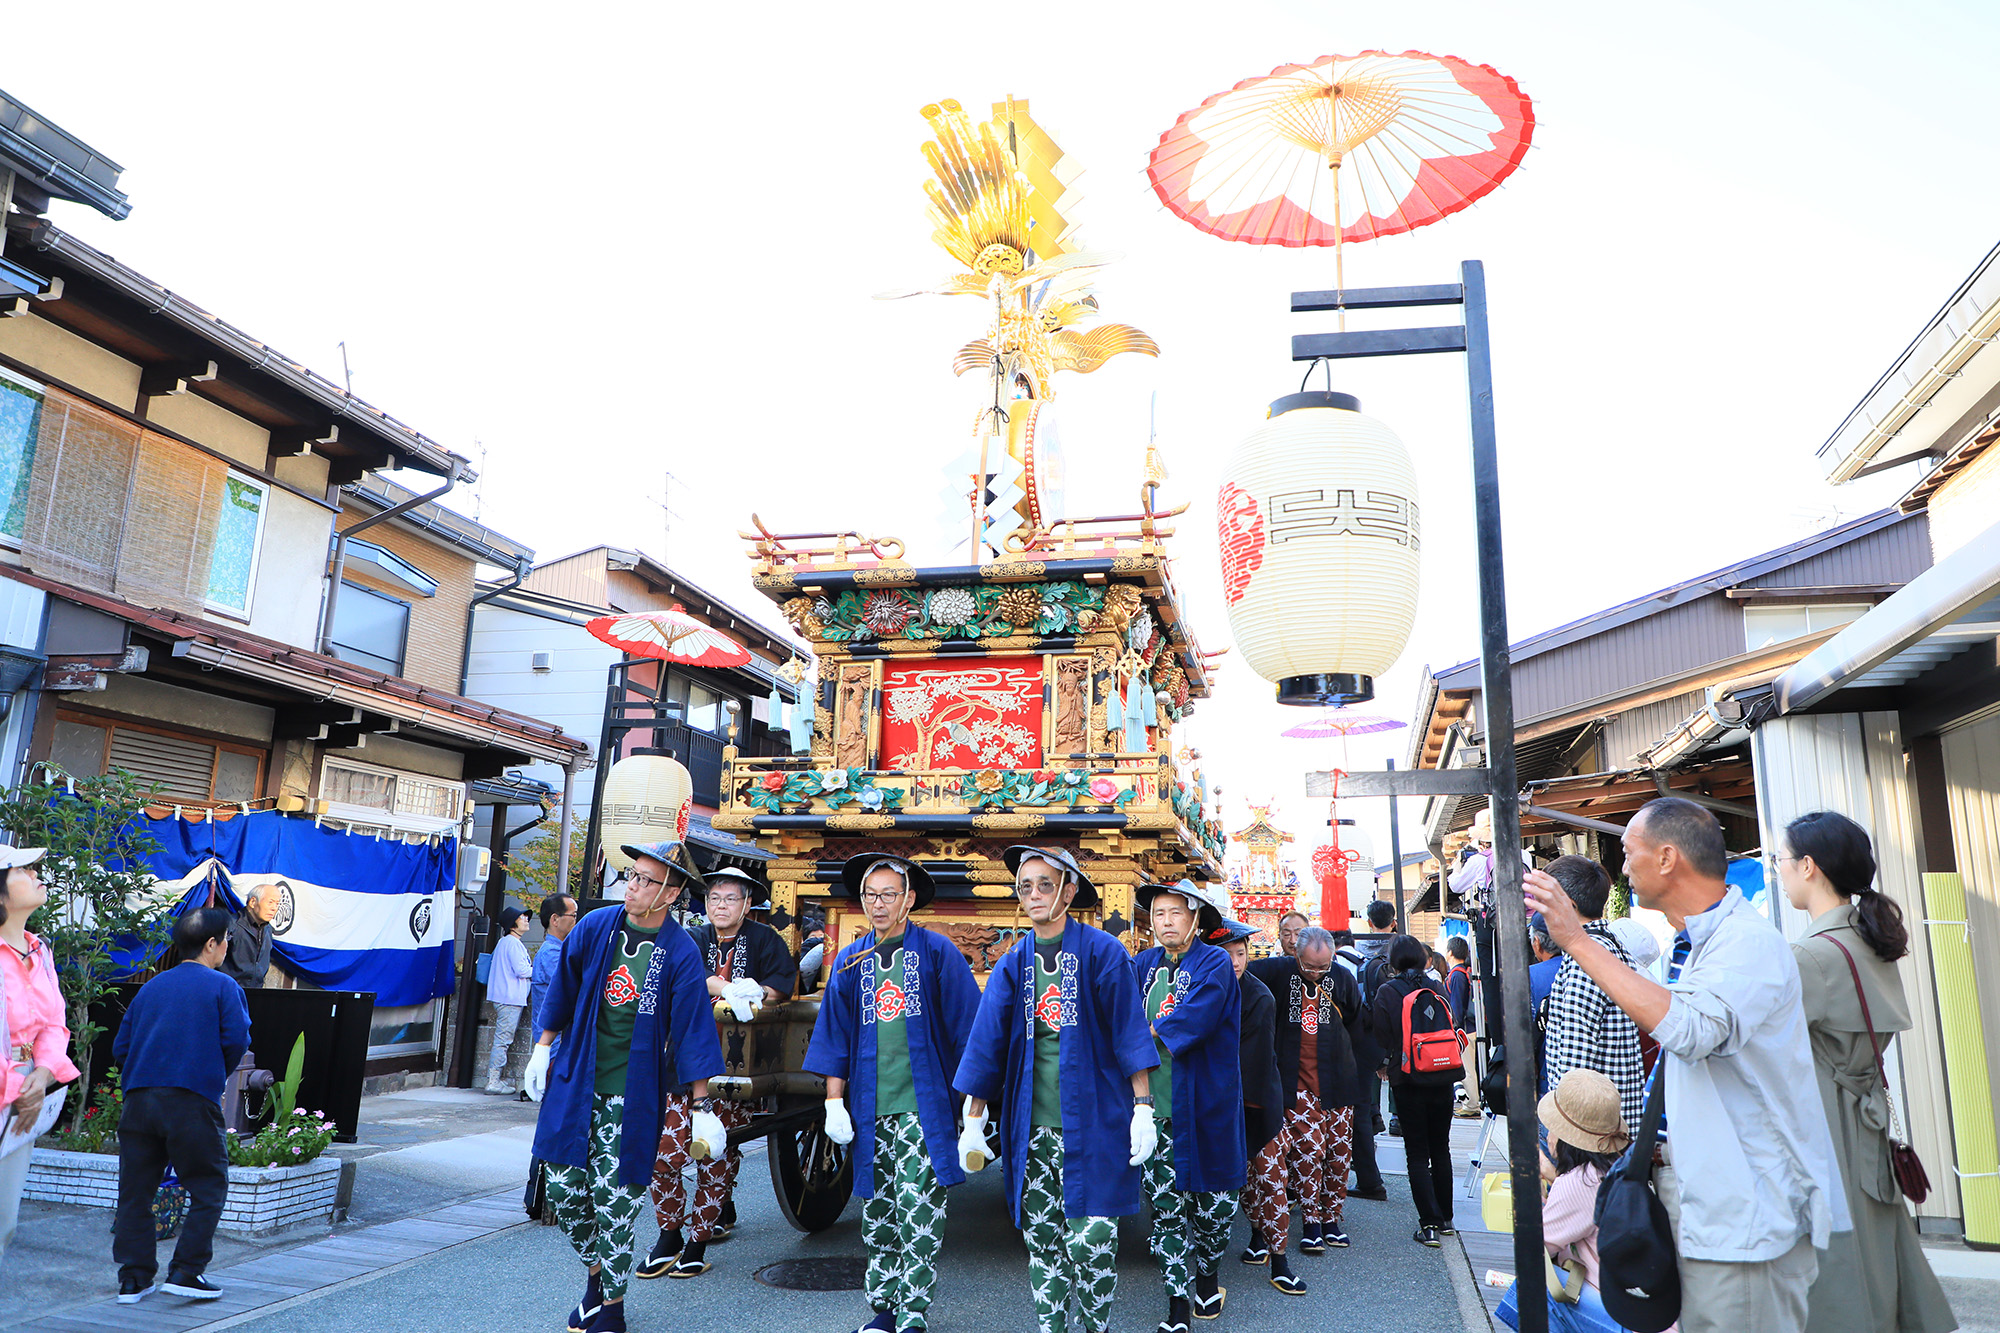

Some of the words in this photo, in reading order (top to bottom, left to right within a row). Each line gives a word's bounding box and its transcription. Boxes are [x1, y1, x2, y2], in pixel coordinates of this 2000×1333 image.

[861, 957, 876, 1025] 保存委員
[903, 950, 921, 1017] 神樂臺
[1060, 952, 1079, 1027] 神樂臺
